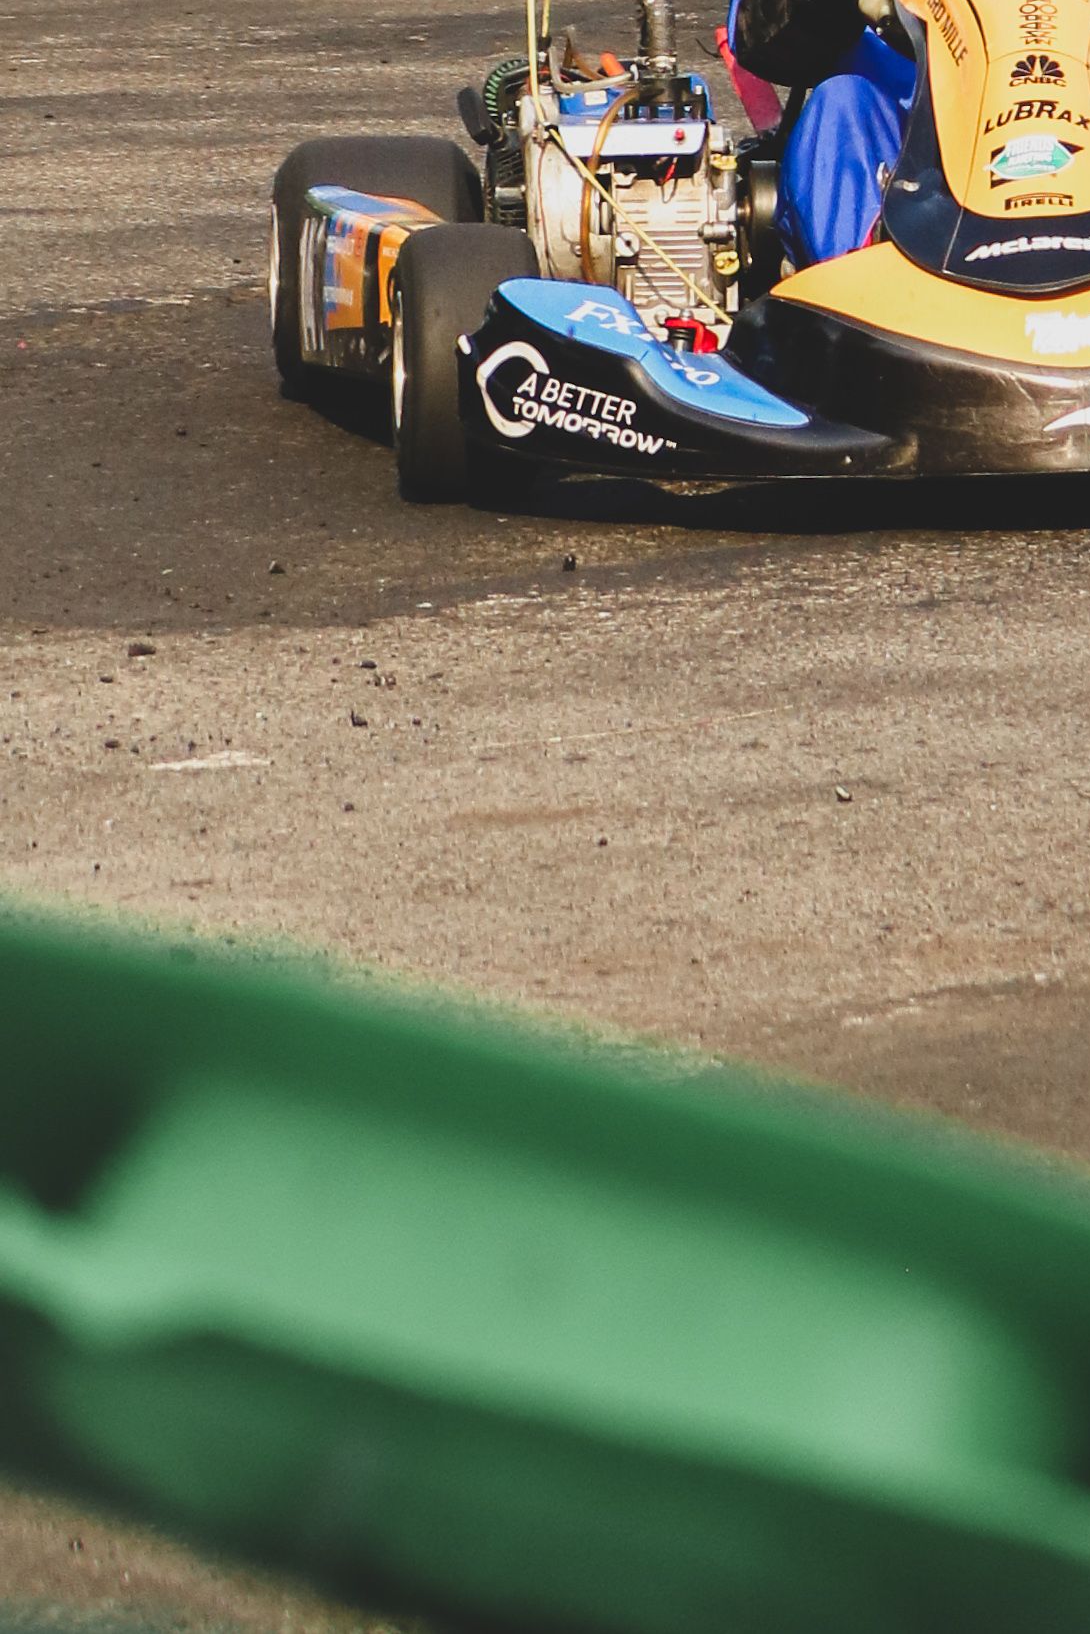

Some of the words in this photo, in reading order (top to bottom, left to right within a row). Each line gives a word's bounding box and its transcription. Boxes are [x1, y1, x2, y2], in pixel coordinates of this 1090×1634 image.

[1009, 76, 1067, 87] CNBC
[1004, 192, 1073, 211] PIRELLI
[516, 372, 538, 397] A
[540, 377, 637, 426] BETTER
[512, 396, 664, 455] TOMORROW
